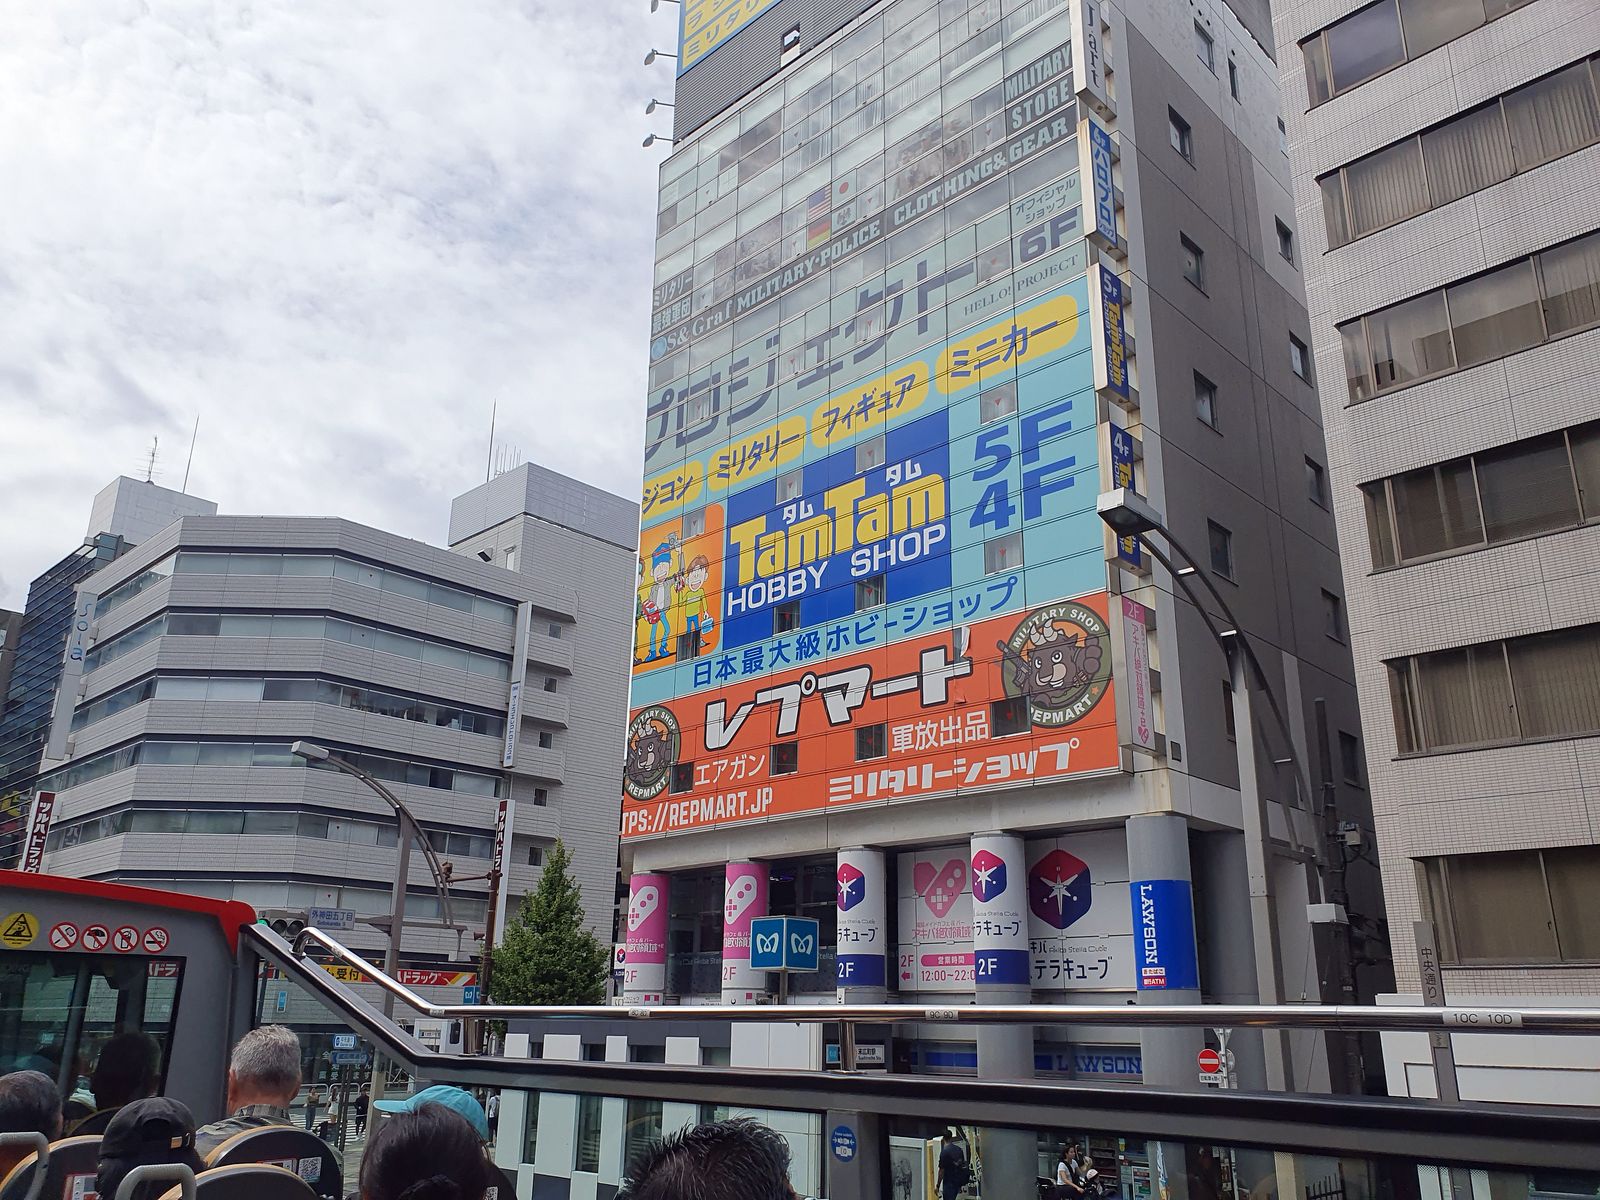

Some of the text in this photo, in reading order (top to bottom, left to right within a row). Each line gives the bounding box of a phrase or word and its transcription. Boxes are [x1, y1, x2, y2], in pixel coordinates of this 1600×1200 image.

[1005, 43, 1073, 102] MILITARY
[1011, 79, 1070, 129] STORE
[1015, 178, 1077, 216] オフィシャル
[1025, 195, 1067, 225] ショップ
[1019, 208, 1078, 264] 6F
[963, 254, 1079, 317] HELLO! PROJECT
[1103, 272, 1118, 297] 5F
[644, 259, 974, 462] プロジェクト
[950, 319, 1059, 379] ミニカー
[822, 373, 916, 439] フィギュア
[717, 430, 800, 480] ミリタリー
[971, 400, 1074, 482] 5F
[1113, 431, 1130, 457] 4F
[969, 455, 1077, 532] 4F
[730, 473, 946, 587] TamTam
[726, 523, 946, 617] HOBBY SHOP
[1012, 607, 1100, 648] MILITARY SHOP
[1127, 601, 1140, 619] 2F
[693, 576, 1018, 688] 日本最大級ホビーショップ
[704, 645, 973, 750] レプマート
[1031, 694, 1092, 724] EPMART
[628, 709, 677, 739] MILITARY SHOP
[892, 710, 989, 754] 軍放出品
[628, 776, 667, 798] REPMART
[694, 753, 766, 786] エアガン
[829, 737, 1080, 802] ミリタリーショップ
[311, 910, 354, 922] 外神田五丁目
[1140, 884, 1158, 965] LAWSON
[624, 970, 638, 983] 2F
[723, 966, 737, 981] 2F
[838, 962, 855, 978] 2F
[900, 954, 914, 968] 2F
[937, 955, 965, 965] 営業時間
[978, 958, 998, 976] 2F
[1420, 946, 1438, 999] 中央通り
[930, 1010, 954, 1019] 9C 9D
[1453, 1012, 1513, 1025] 10C 10D
[1056, 1054, 1143, 1074] LAWSON
